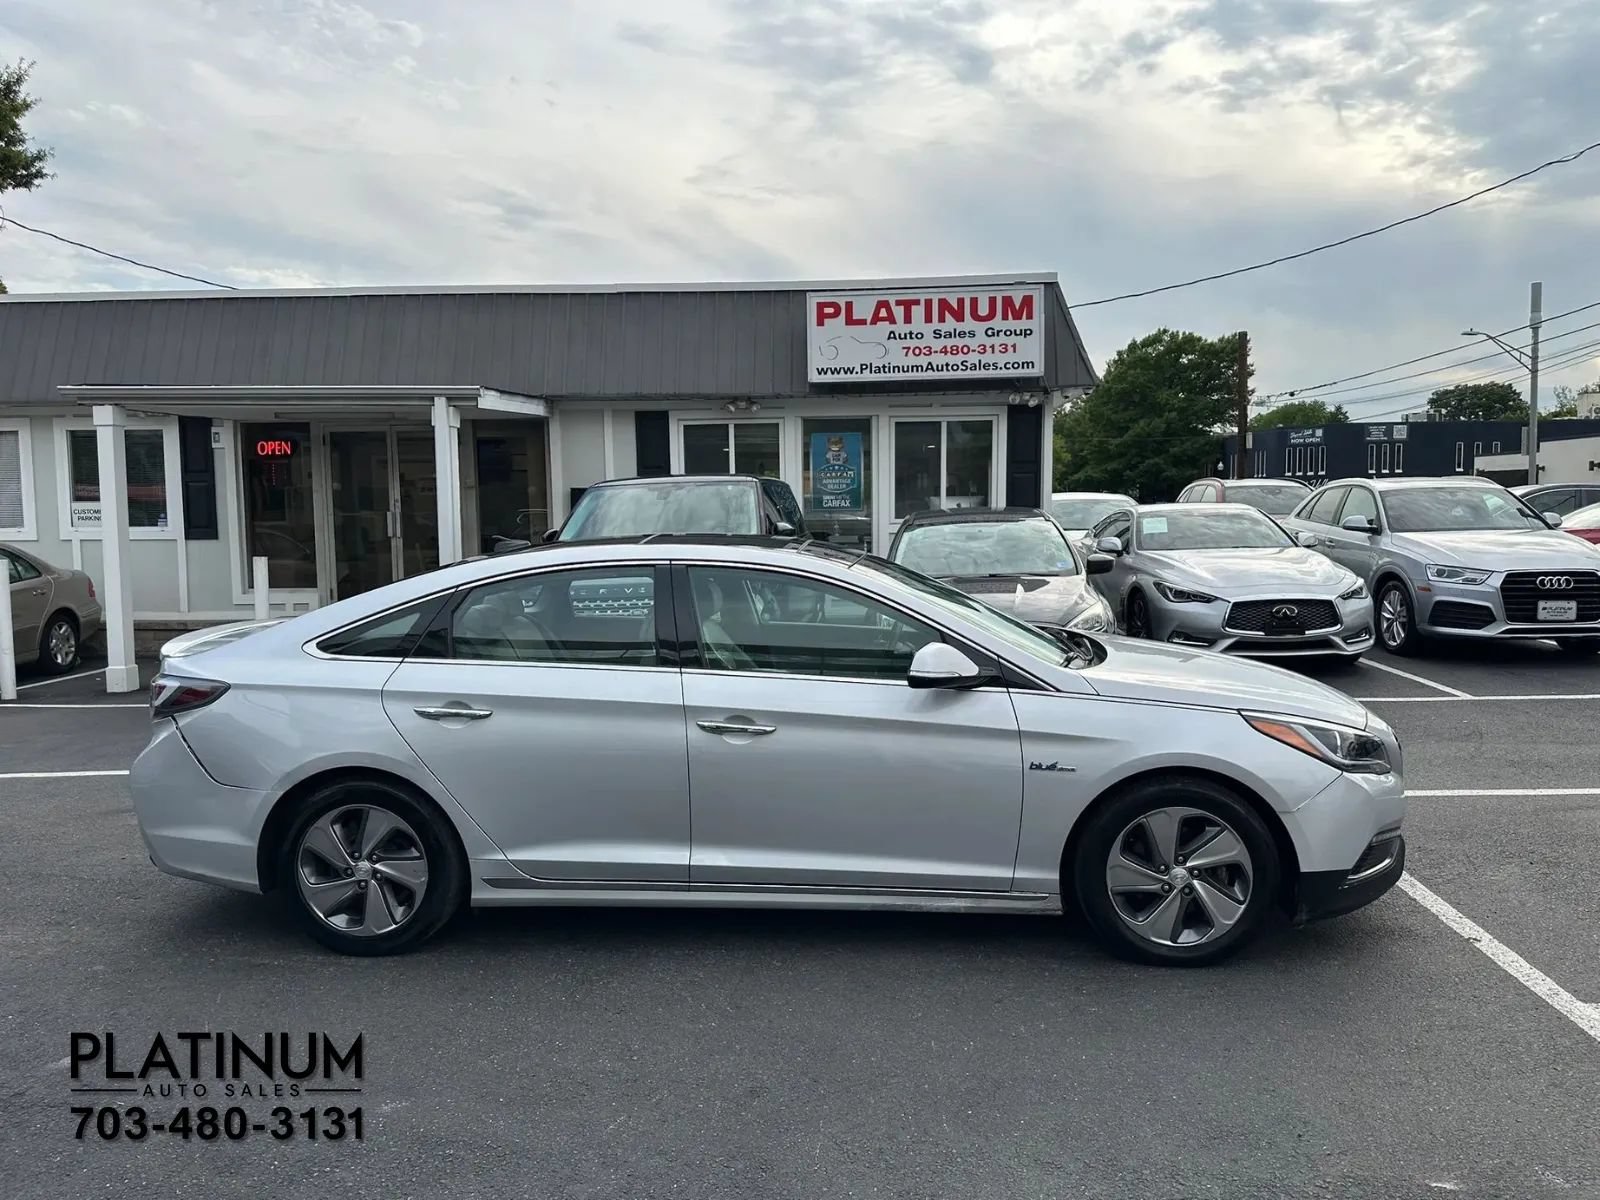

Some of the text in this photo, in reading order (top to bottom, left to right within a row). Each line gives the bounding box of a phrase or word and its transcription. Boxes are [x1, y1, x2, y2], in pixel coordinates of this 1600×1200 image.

[815, 294, 1034, 327] PLATINUM
[887, 326, 1034, 341] Auto Sales Group
[901, 343, 1018, 358] 703-480-3131
[816, 359, 1035, 376] www.PlatinumAutoSales.com
[257, 440, 291, 456] OPEN
